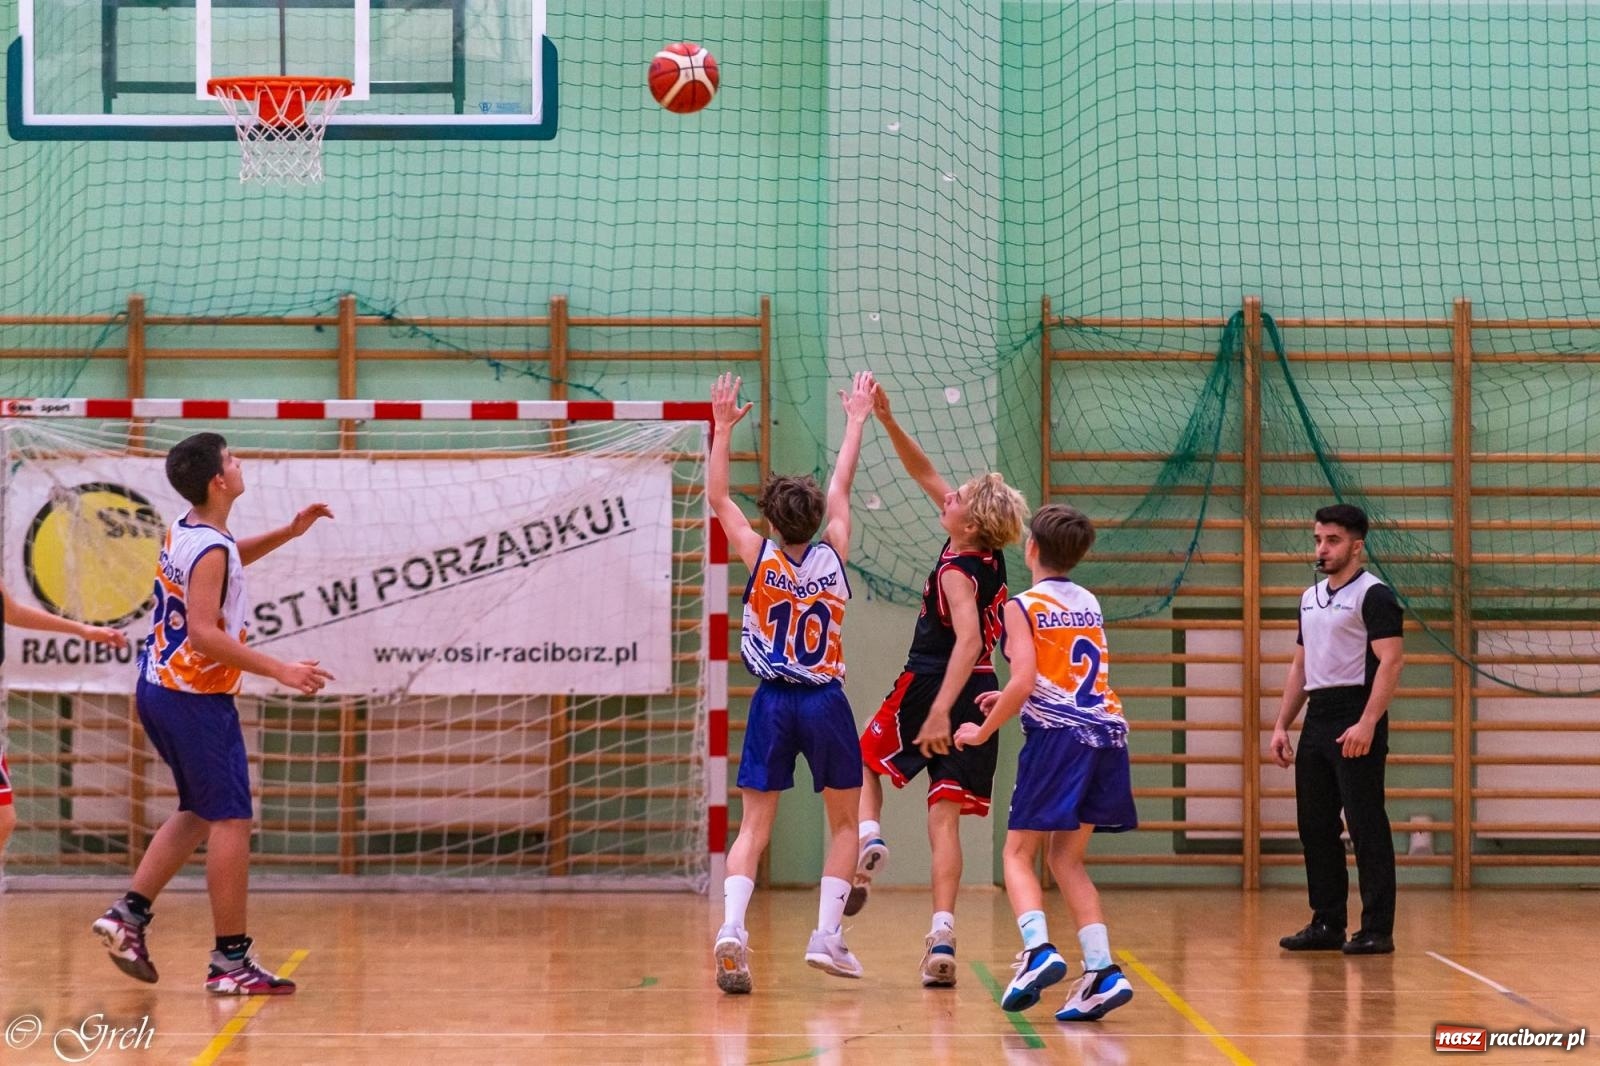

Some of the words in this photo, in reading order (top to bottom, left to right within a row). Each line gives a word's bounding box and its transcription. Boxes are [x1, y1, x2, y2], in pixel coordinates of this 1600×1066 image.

[246, 589, 306, 642] ST
[318, 577, 359, 617] W
[372, 495, 632, 602] PORZĄDKU!
[374, 641, 638, 667] www.osir-raciborz.pl
[767, 600, 831, 667] 10
[1072, 638, 1105, 708] 2
